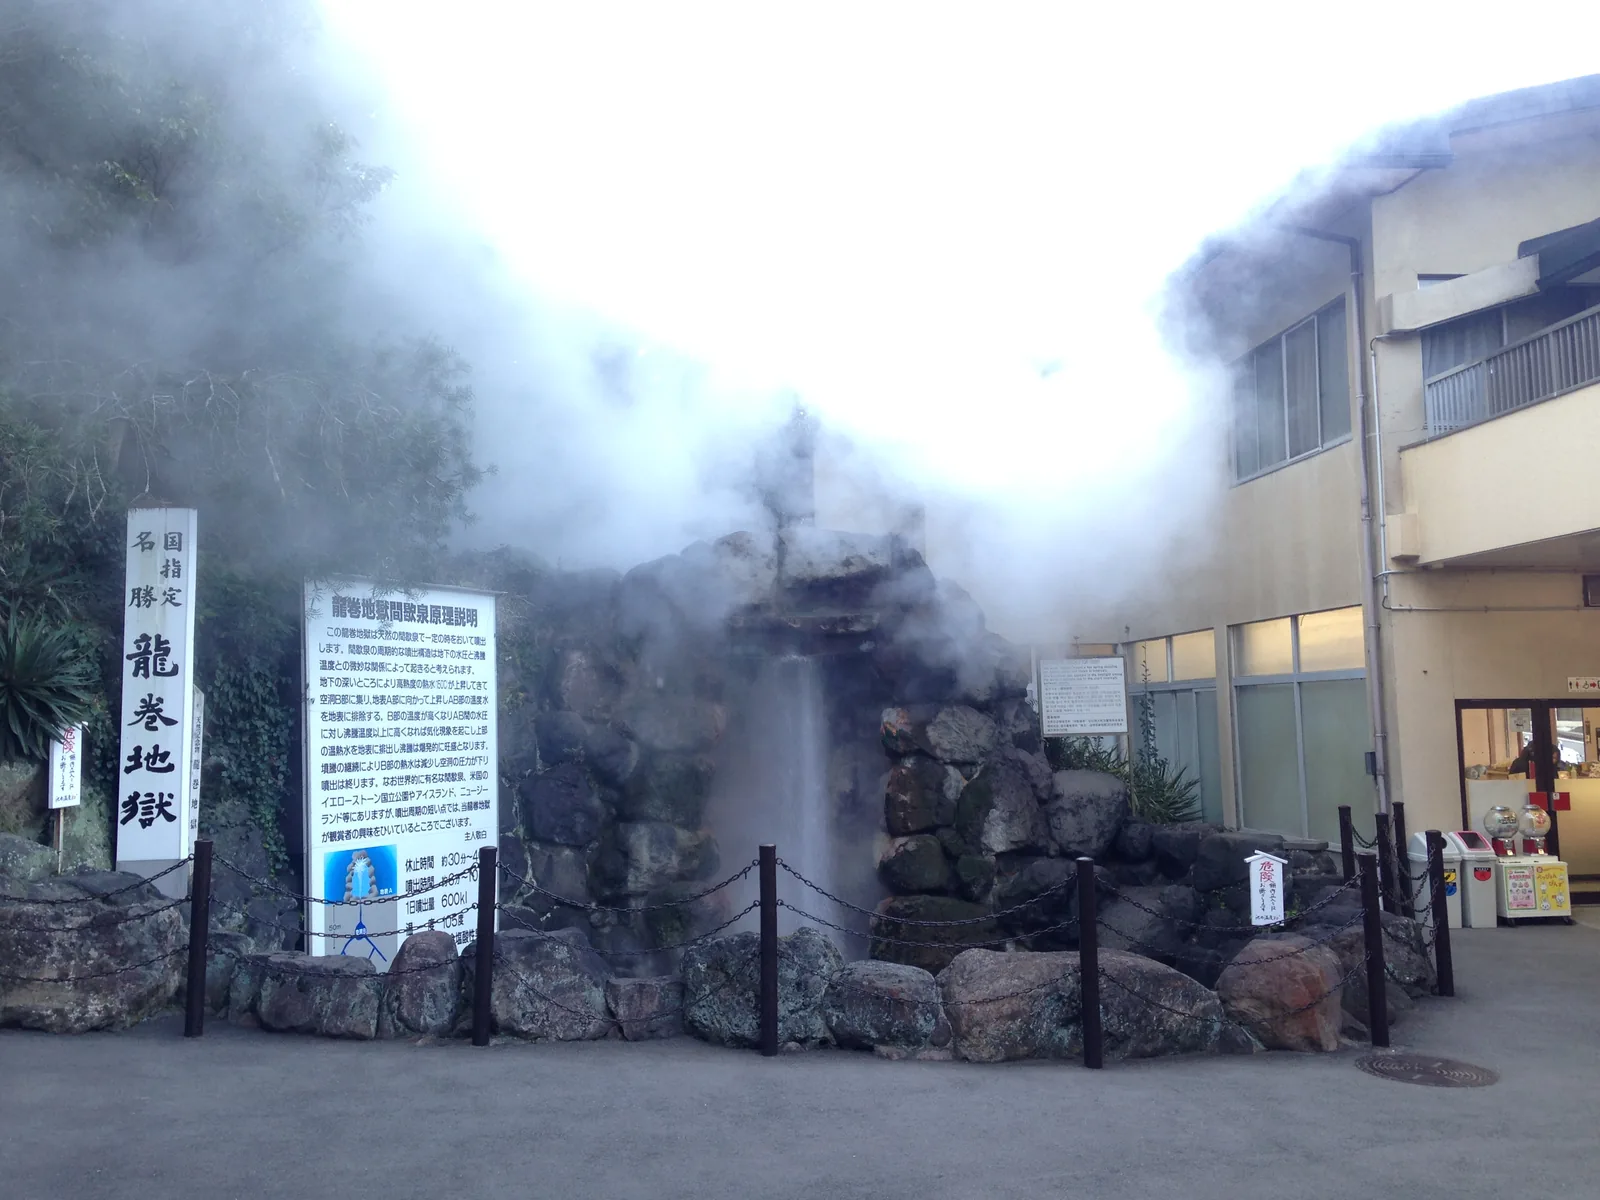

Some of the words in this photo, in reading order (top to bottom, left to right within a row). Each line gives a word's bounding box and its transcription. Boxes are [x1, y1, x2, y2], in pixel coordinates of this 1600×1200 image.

[128, 531, 158, 609] 名勝
[160, 531, 183, 607] 国指定
[120, 633, 178, 830] 龍巻地獄
[405, 855, 435, 872] 休止時間
[1259, 861, 1274, 883] 危険
[405, 896, 435, 915] 1日噴出量
